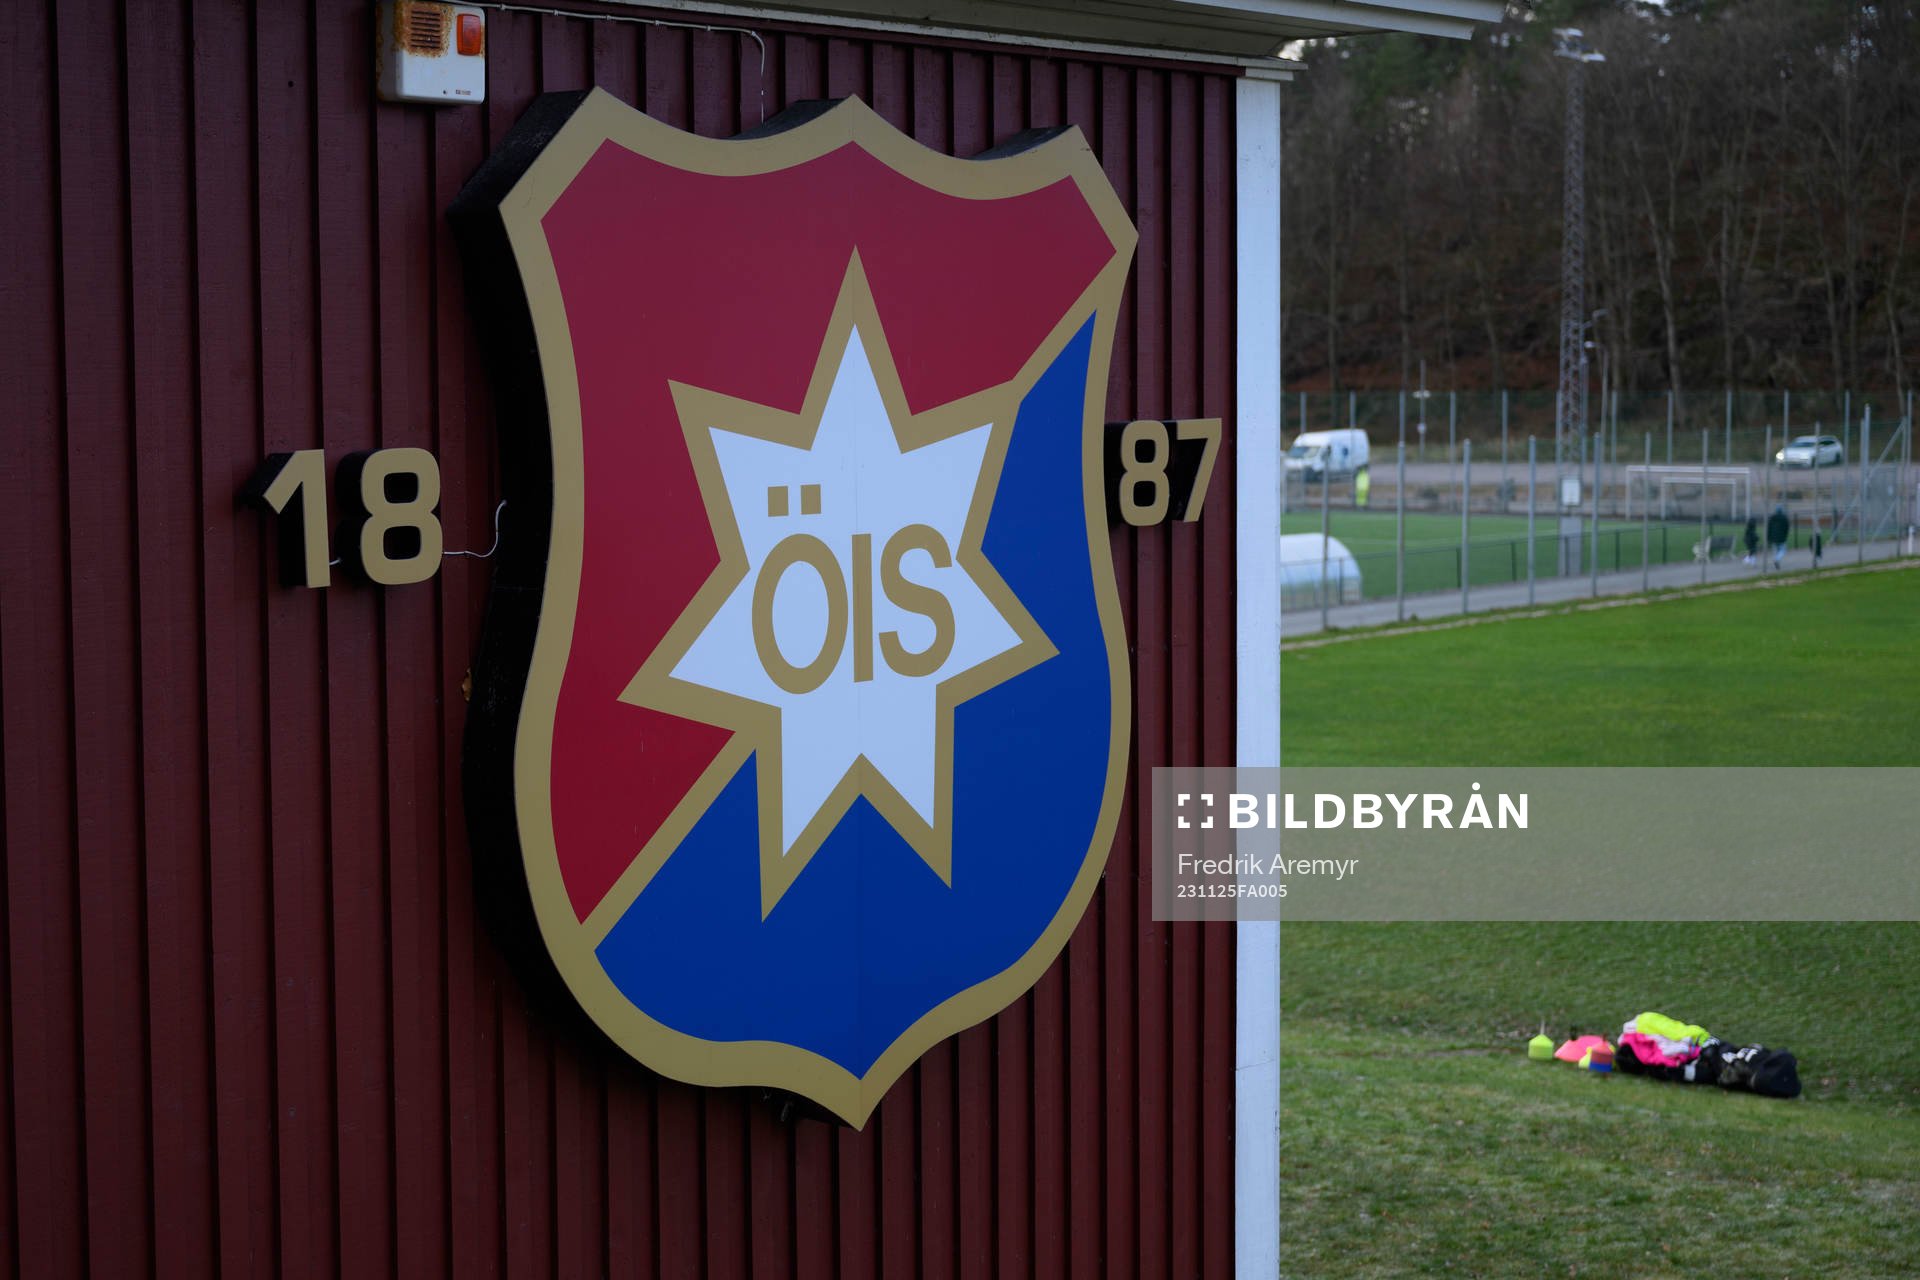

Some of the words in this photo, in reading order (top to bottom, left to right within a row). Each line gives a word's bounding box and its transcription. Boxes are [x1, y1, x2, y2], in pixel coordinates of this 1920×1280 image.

[262, 448, 442, 588] 18
[1119, 418, 1222, 526] 87
[753, 484, 955, 694] ÖIS
